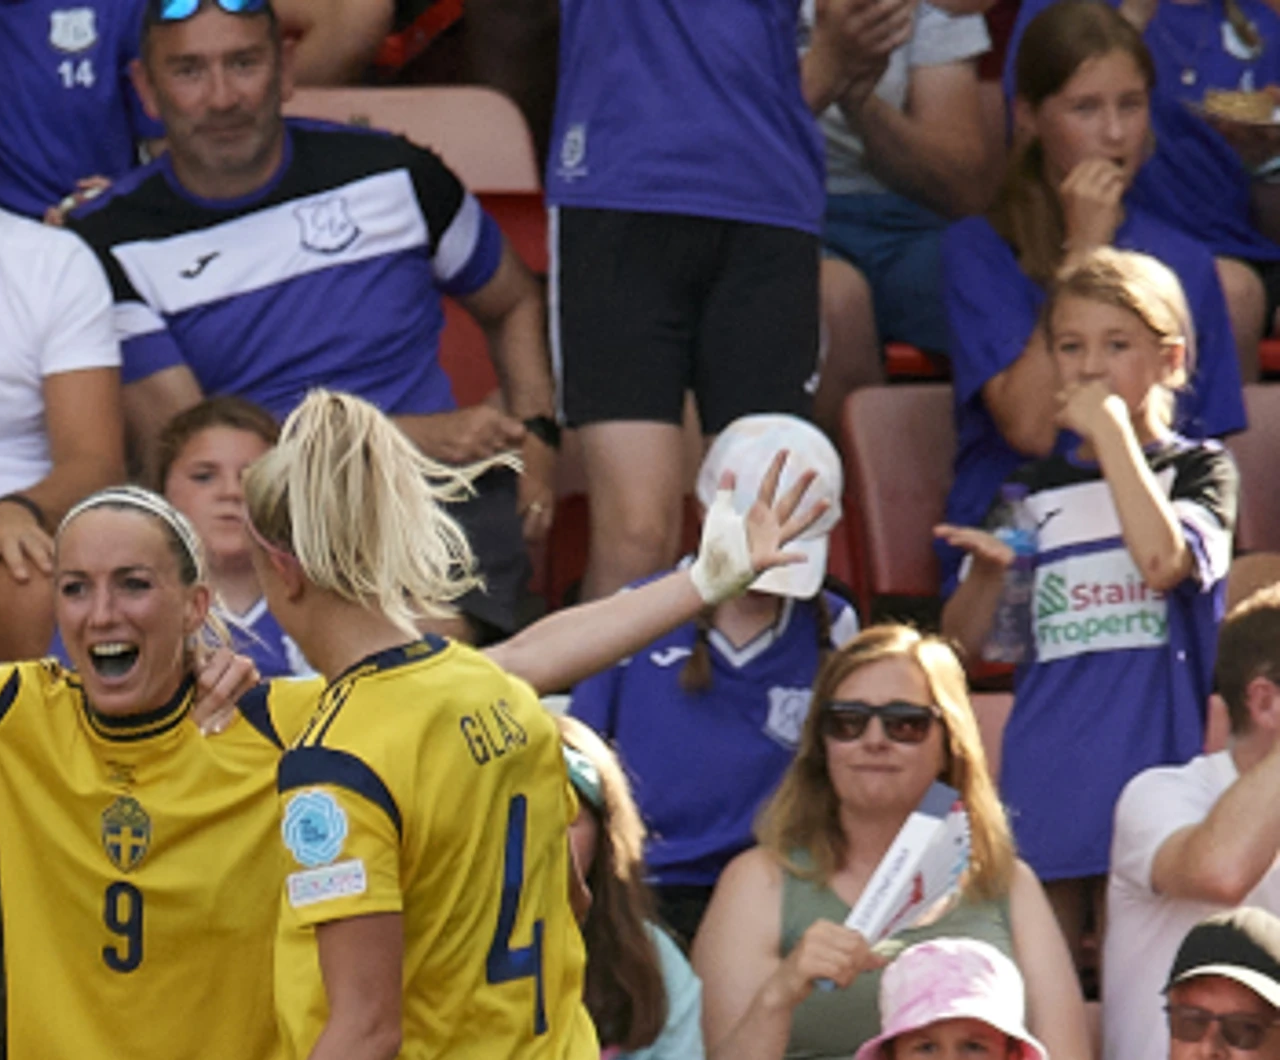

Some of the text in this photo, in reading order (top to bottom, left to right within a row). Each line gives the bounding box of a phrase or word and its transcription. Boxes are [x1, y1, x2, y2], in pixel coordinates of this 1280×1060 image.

[57, 59, 96, 89] 14
[460, 698, 528, 766] GLAS
[101, 879, 144, 974] 9
[486, 792, 549, 1037] 4
